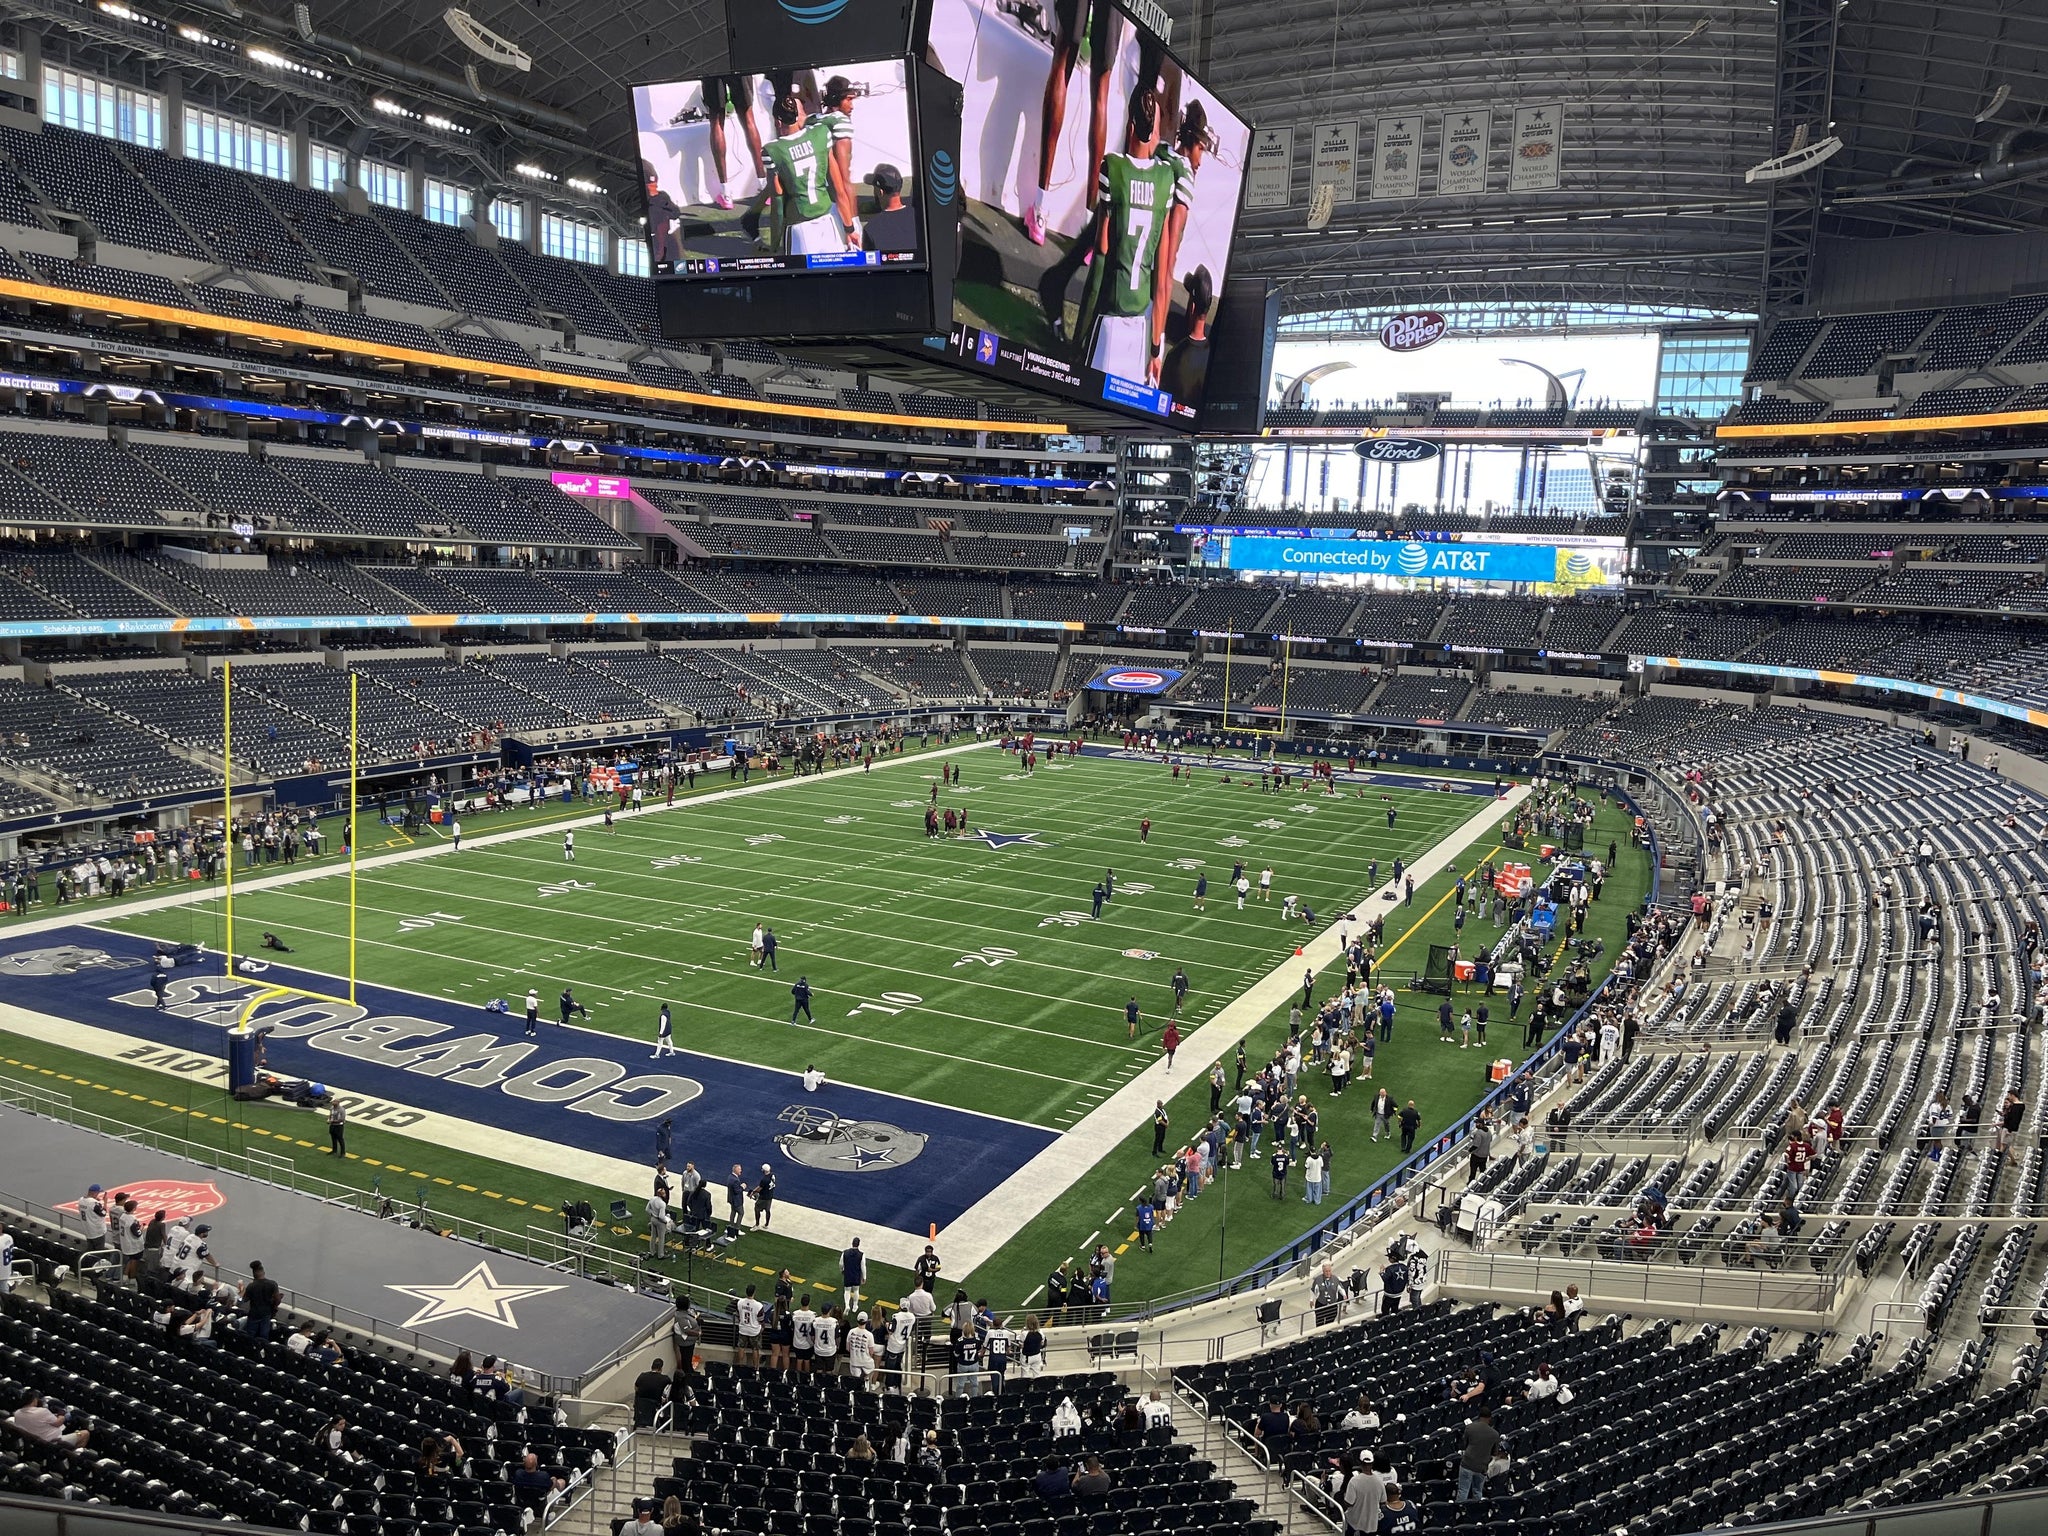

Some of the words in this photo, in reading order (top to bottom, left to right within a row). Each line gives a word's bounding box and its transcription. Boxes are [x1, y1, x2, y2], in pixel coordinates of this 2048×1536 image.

[1453, 128, 1478, 136] DALLAS
[1525, 122, 1550, 130] DALLAS
[1450, 134, 1480, 142] COWBOYS
[1522, 129, 1553, 138] COWBOYS
[788, 140, 814, 160] FIELDS
[793, 155, 818, 205] 7
[1441, 177, 1482, 186] CHAMPIONS
[1513, 173, 1556, 181] CHAMPIONS
[1375, 181, 1415, 189] CHAMPIONS
[1130, 180, 1155, 206] FIELDS
[1127, 208, 1153, 290] 7
[1404, 316, 1428, 333] Dr
[1389, 320, 1443, 348] Pepper
[97, 343, 115, 351] TROY
[117, 345, 144, 354] AIKMAN
[950, 331, 958, 345] 14
[967, 337, 974, 350] 6
[1000, 349, 1022, 363] HALFTIME
[1027, 351, 1046, 365] VIKINGS
[1047, 357, 1070, 372] RECEIVING
[241, 363, 266, 373] EMMITT
[267, 367, 287, 376] SMITH
[12, 378, 30, 389] CITY
[30, 381, 60, 392] CHIEFS
[1055, 371, 1064, 383] REC,
[1071, 376, 1081, 386] YDS
[366, 381, 385, 389] LARRY
[387, 384, 405, 392] ALLEN
[422, 427, 444, 437] DALLAS
[444, 429, 470, 440] COWBOYS
[477, 432, 499, 442] KANSAS
[499, 435, 511, 443] CITY
[512, 436, 530, 446] CHIEFS
[1370, 441, 1421, 460] Ford
[233, 524, 254, 536] 90:00
[1357, 530, 1378, 538] 90:00
[1283, 548, 1367, 565] Connected
[1371, 551, 1391, 569] by
[1432, 551, 1490, 571] AT&T
[43, 625, 81, 635] Scheduling
[1123, 625, 1166, 634] Blockchain.com
[1363, 639, 1413, 648] Blockchain.com
[1452, 644, 1504, 654] Blockchain.com
[1547, 650, 1601, 661] Blockchain.com
[1628, 660, 1643, 671] 25
[1730, 664, 1755, 674] Scheduling
[653, 854, 703, 868] 30
[540, 879, 596, 895] 20
[1112, 882, 1155, 895] 40
[399, 911, 466, 929] 10
[1043, 910, 1093, 927] 30
[960, 946, 1018, 967] 20
[855, 991, 923, 1017] 10
[107, 974, 704, 1122] COWBOYS
[118, 1045, 230, 1080] LOVE
[1795, 1152, 1806, 1162] 21
[799, 1323, 809, 1337] 4
[820, 1330, 829, 1344] 4
[901, 1326, 909, 1340] 4
[993, 1339, 1006, 1354] 88
[964, 1350, 976, 1362] 17
